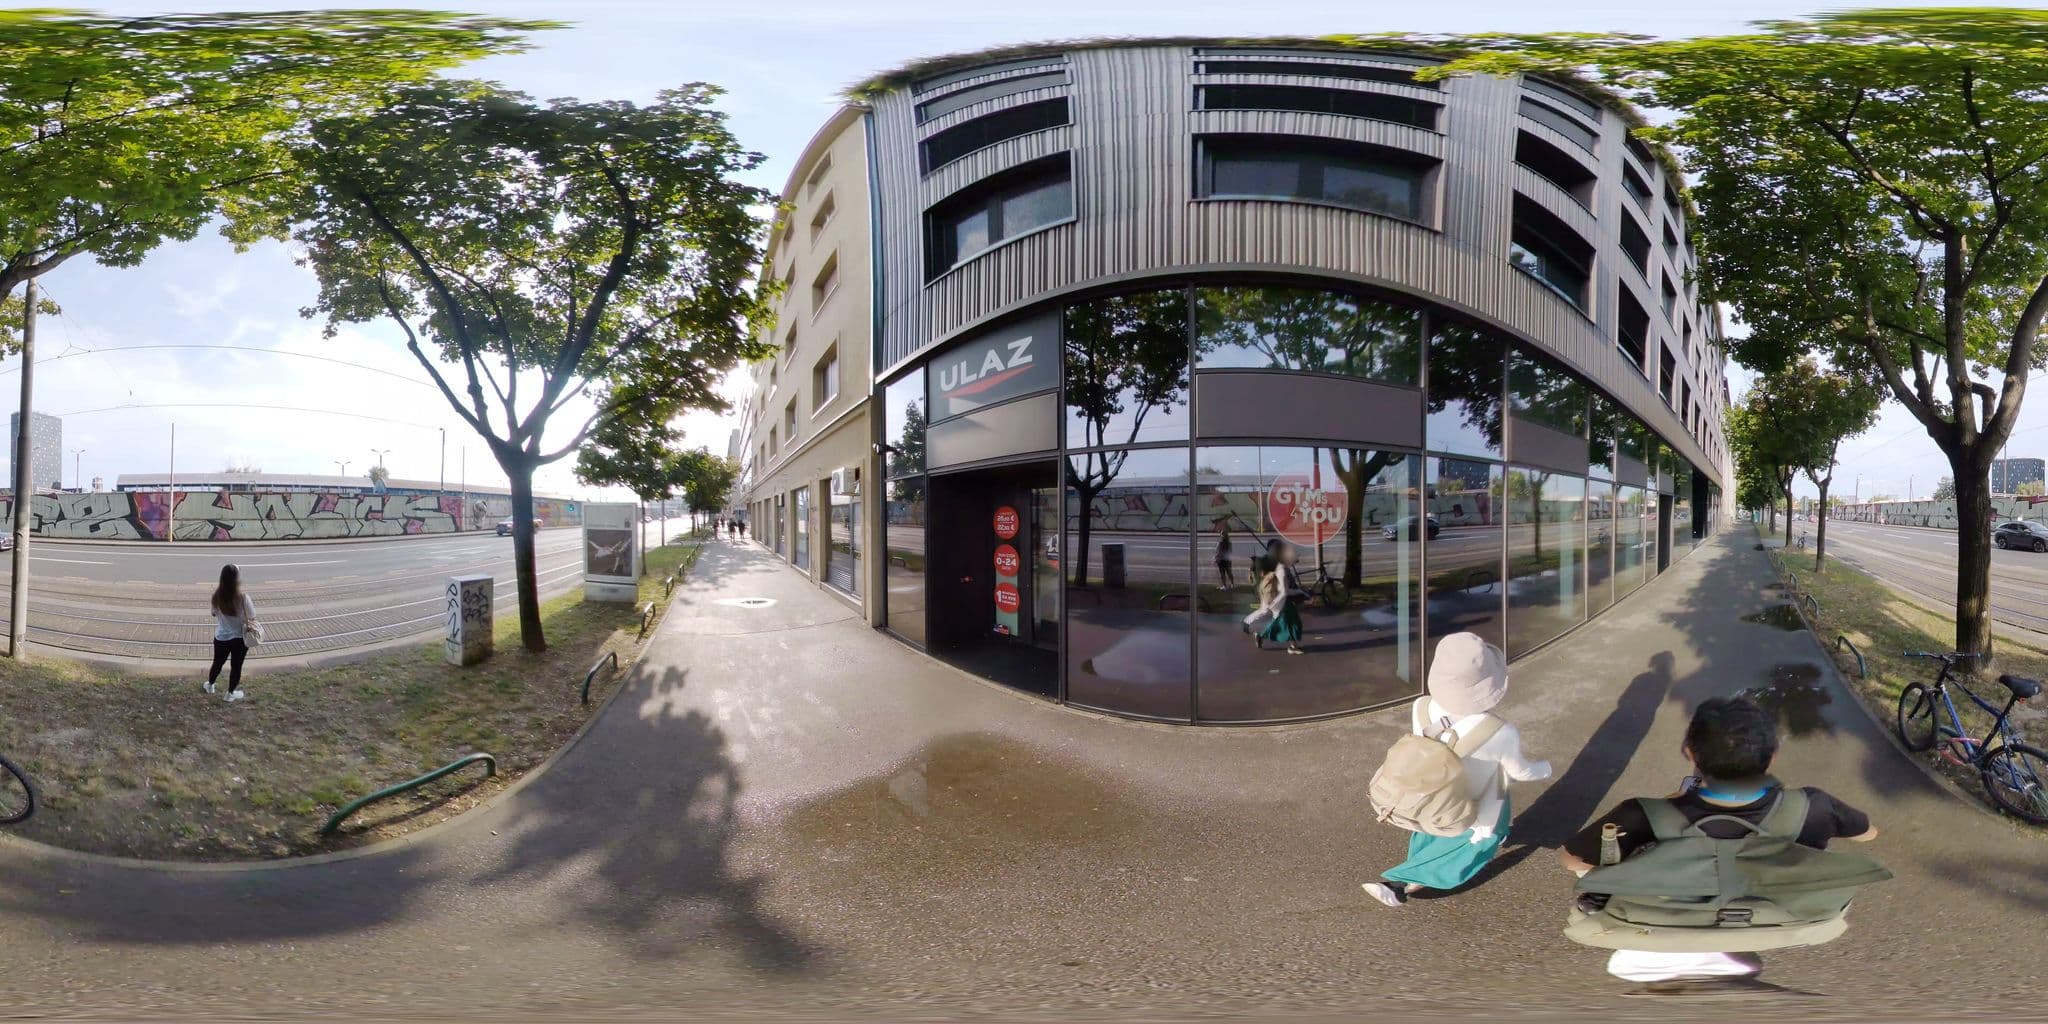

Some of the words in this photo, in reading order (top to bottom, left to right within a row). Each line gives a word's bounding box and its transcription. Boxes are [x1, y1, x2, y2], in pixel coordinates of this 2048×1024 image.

[940, 336, 1033, 391] ULAZ
[1300, 501, 1342, 523] YOU
[996, 557, 1017, 567] 0-24
